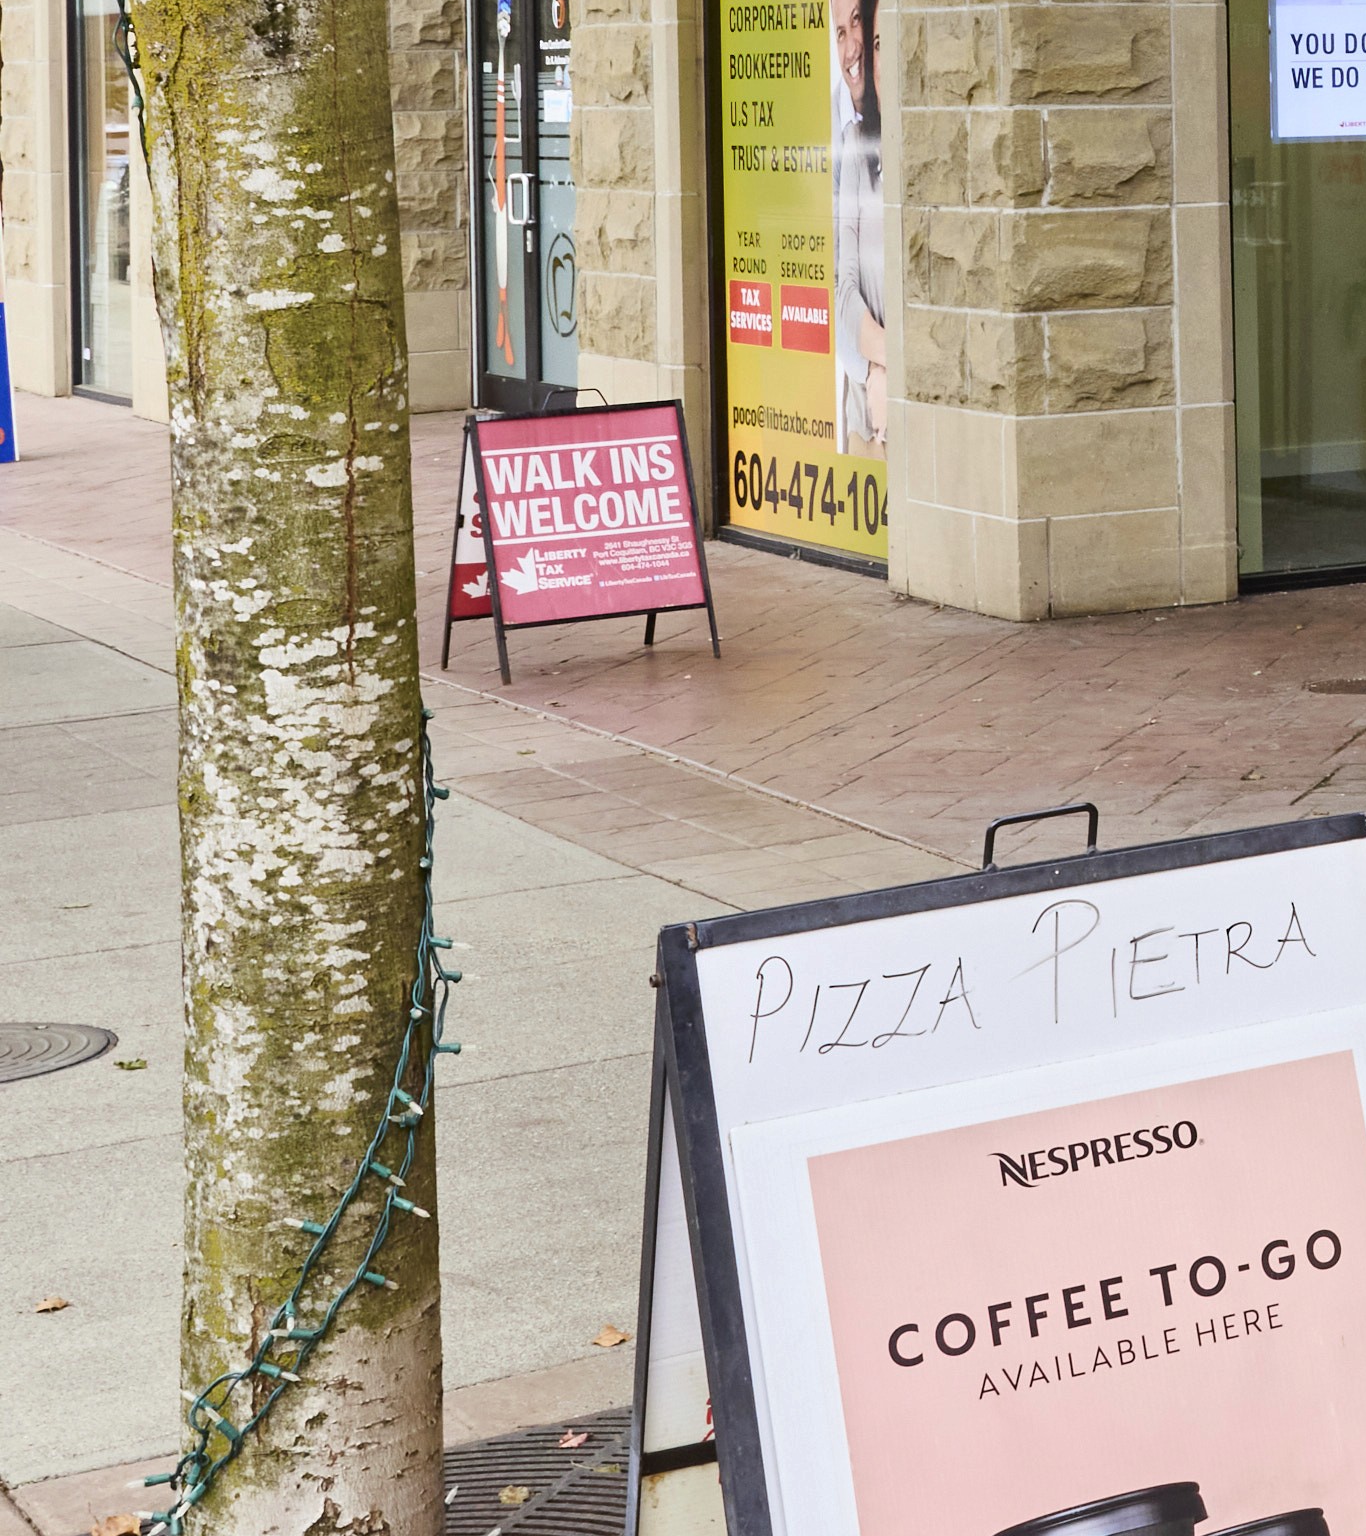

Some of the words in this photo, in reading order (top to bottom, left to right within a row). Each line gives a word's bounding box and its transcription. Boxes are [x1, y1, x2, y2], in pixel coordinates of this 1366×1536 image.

[729, 4, 797, 33] CORPORATE
[801, 2, 825, 29] TAX
[1290, 33, 1336, 55] YOU
[729, 51, 811, 80] BOOKKEEPING
[1291, 67, 1323, 89] WE
[1332, 66, 1359, 88] DO
[730, 101, 748, 127] U.S
[752, 101, 774, 127] TAX
[731, 145, 767, 171] TRUST
[771, 146, 779, 171] &
[783, 145, 828, 174] ESTATE
[737, 231, 761, 248] YEAR
[781, 233, 805, 252] DROP
[808, 235, 825, 252] OFF
[733, 257, 767, 275] ROUND
[780, 262, 825, 281] SERVICES
[741, 288, 760, 307] TAX
[730, 310, 772, 333] SERVICES
[781, 304, 828, 326] AVAILABLE
[733, 405, 834, 441] poco@libtaxbc.com
[485, 449, 602, 495] WALK
[609, 443, 675, 485] INS
[491, 485, 684, 538] WELCOME
[534, 548, 587, 563] LIBERTY
[649, 545, 660, 553] BC
[535, 563, 564, 576] TAX
[538, 574, 592, 590] SERVICE
[748, 956, 982, 1064] PIZZA
[1008, 898, 1317, 1024] PIETRA
[987, 1120, 1202, 1188] NESPRESSO
[887, 1275, 1130, 1367] COFFEE
[1149, 1228, 1343, 1308] TO-GO
[977, 1331, 1181, 1400] AVAILABLE
[1196, 1303, 1284, 1348] HERE
